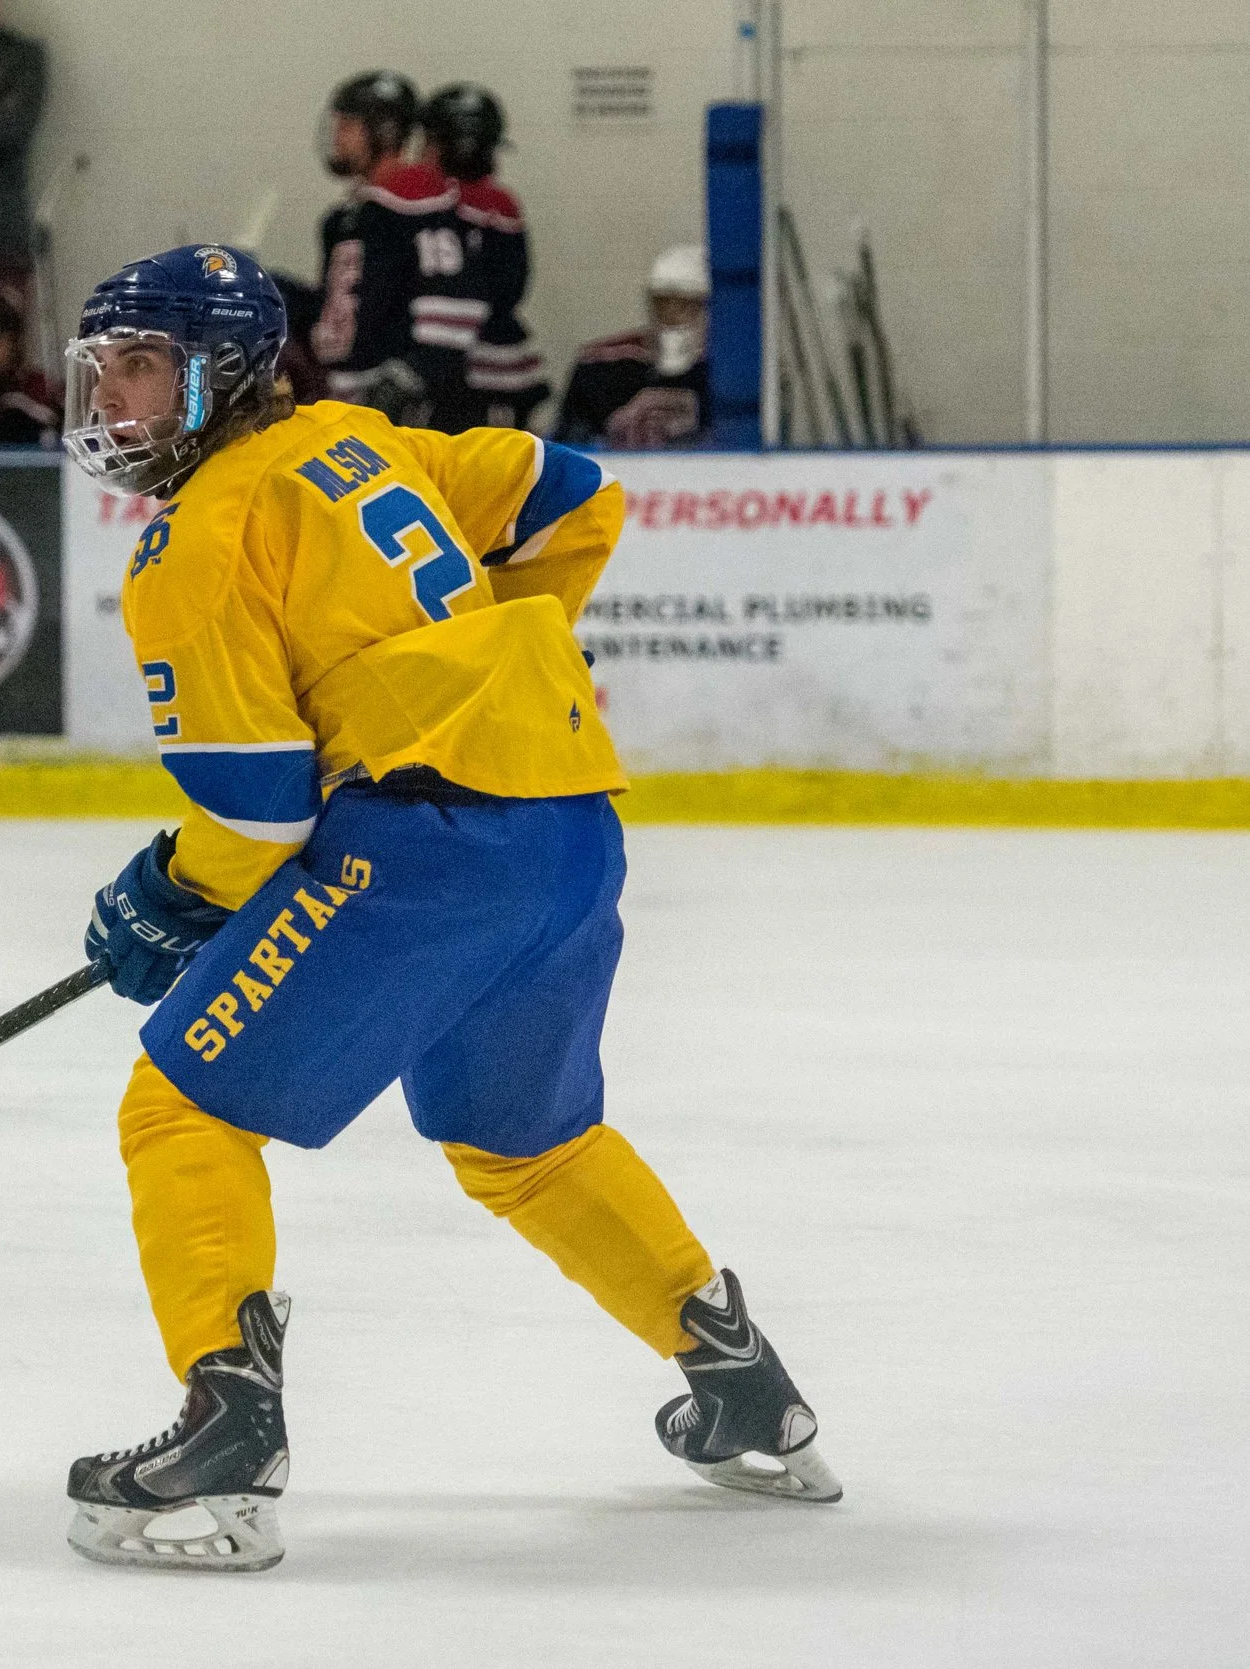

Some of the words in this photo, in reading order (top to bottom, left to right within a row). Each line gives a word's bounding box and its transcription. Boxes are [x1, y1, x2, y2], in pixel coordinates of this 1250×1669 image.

[211, 308, 254, 318] BAUER
[186, 358, 201, 428] BAUER
[294, 435, 391, 503] WILSON
[357, 481, 476, 624] 2
[583, 596, 730, 623] MERCIAL
[743, 596, 931, 624] PLUMBING
[117, 892, 202, 952] BAU
